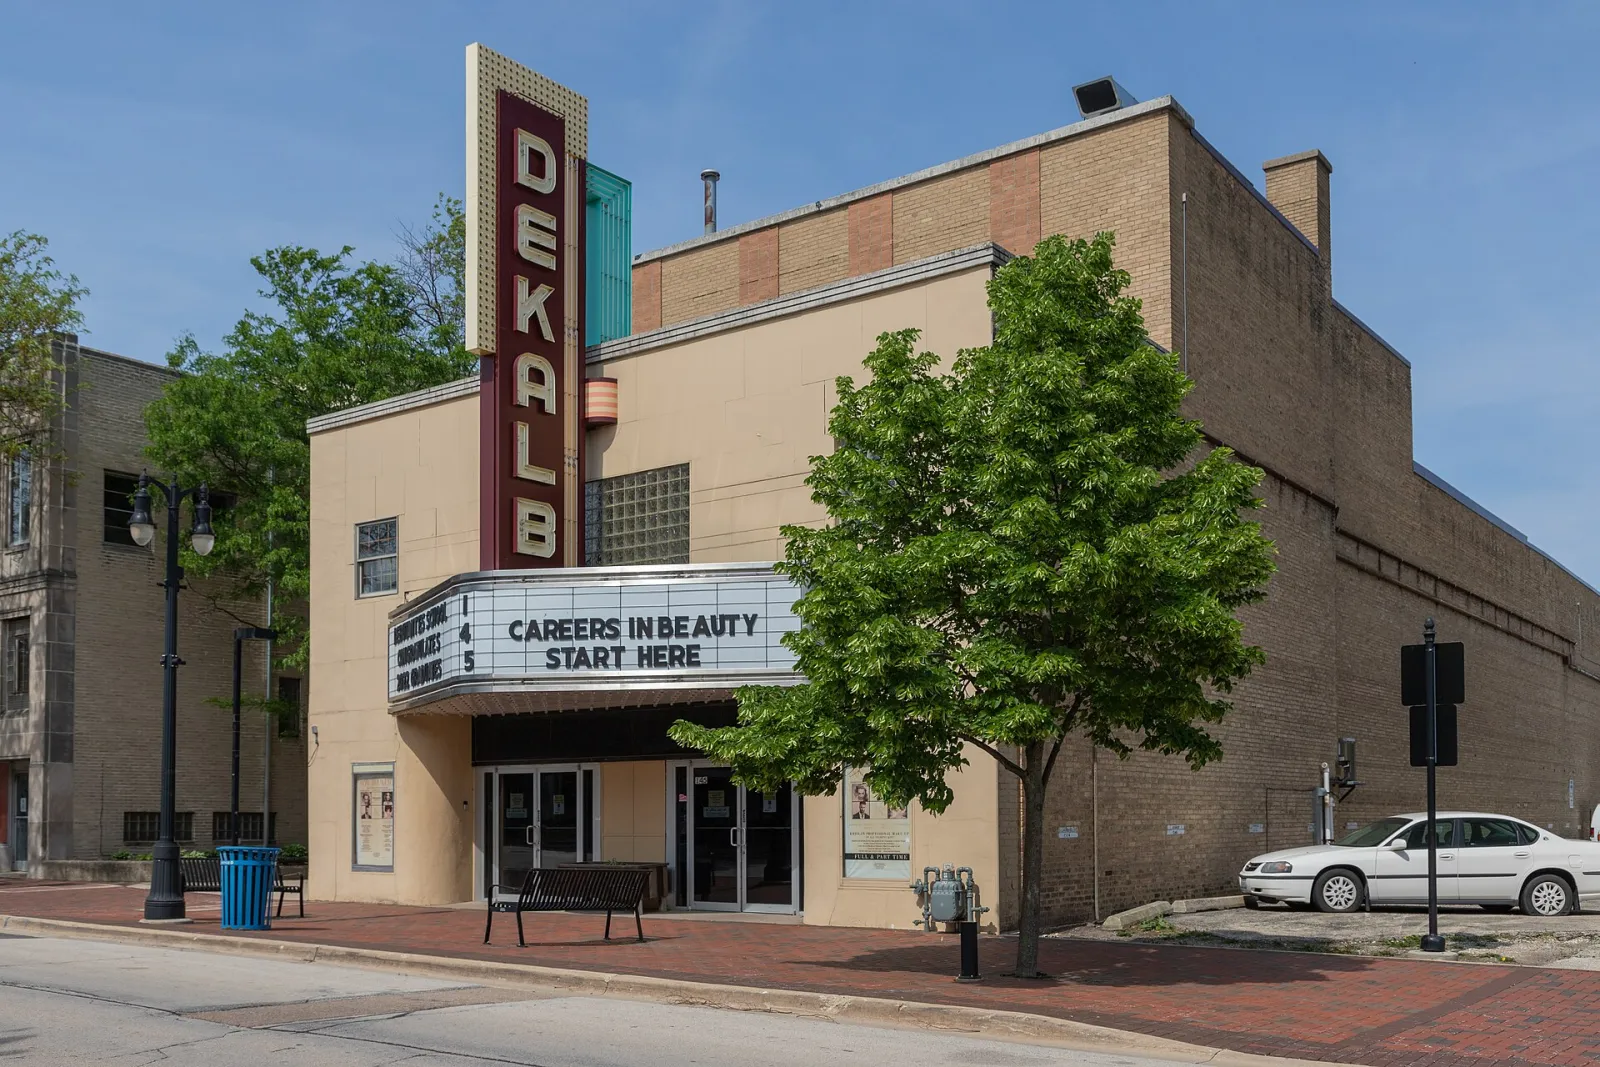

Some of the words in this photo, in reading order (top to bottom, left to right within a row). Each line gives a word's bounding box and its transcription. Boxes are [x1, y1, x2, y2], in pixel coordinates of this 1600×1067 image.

[513, 127, 557, 559] DEKALB
[508, 617, 621, 642] CAREERS
[628, 616, 653, 640] IN
[657, 613, 758, 640] BEAUTY
[545, 645, 626, 670] START
[637, 643, 701, 668] HERE
